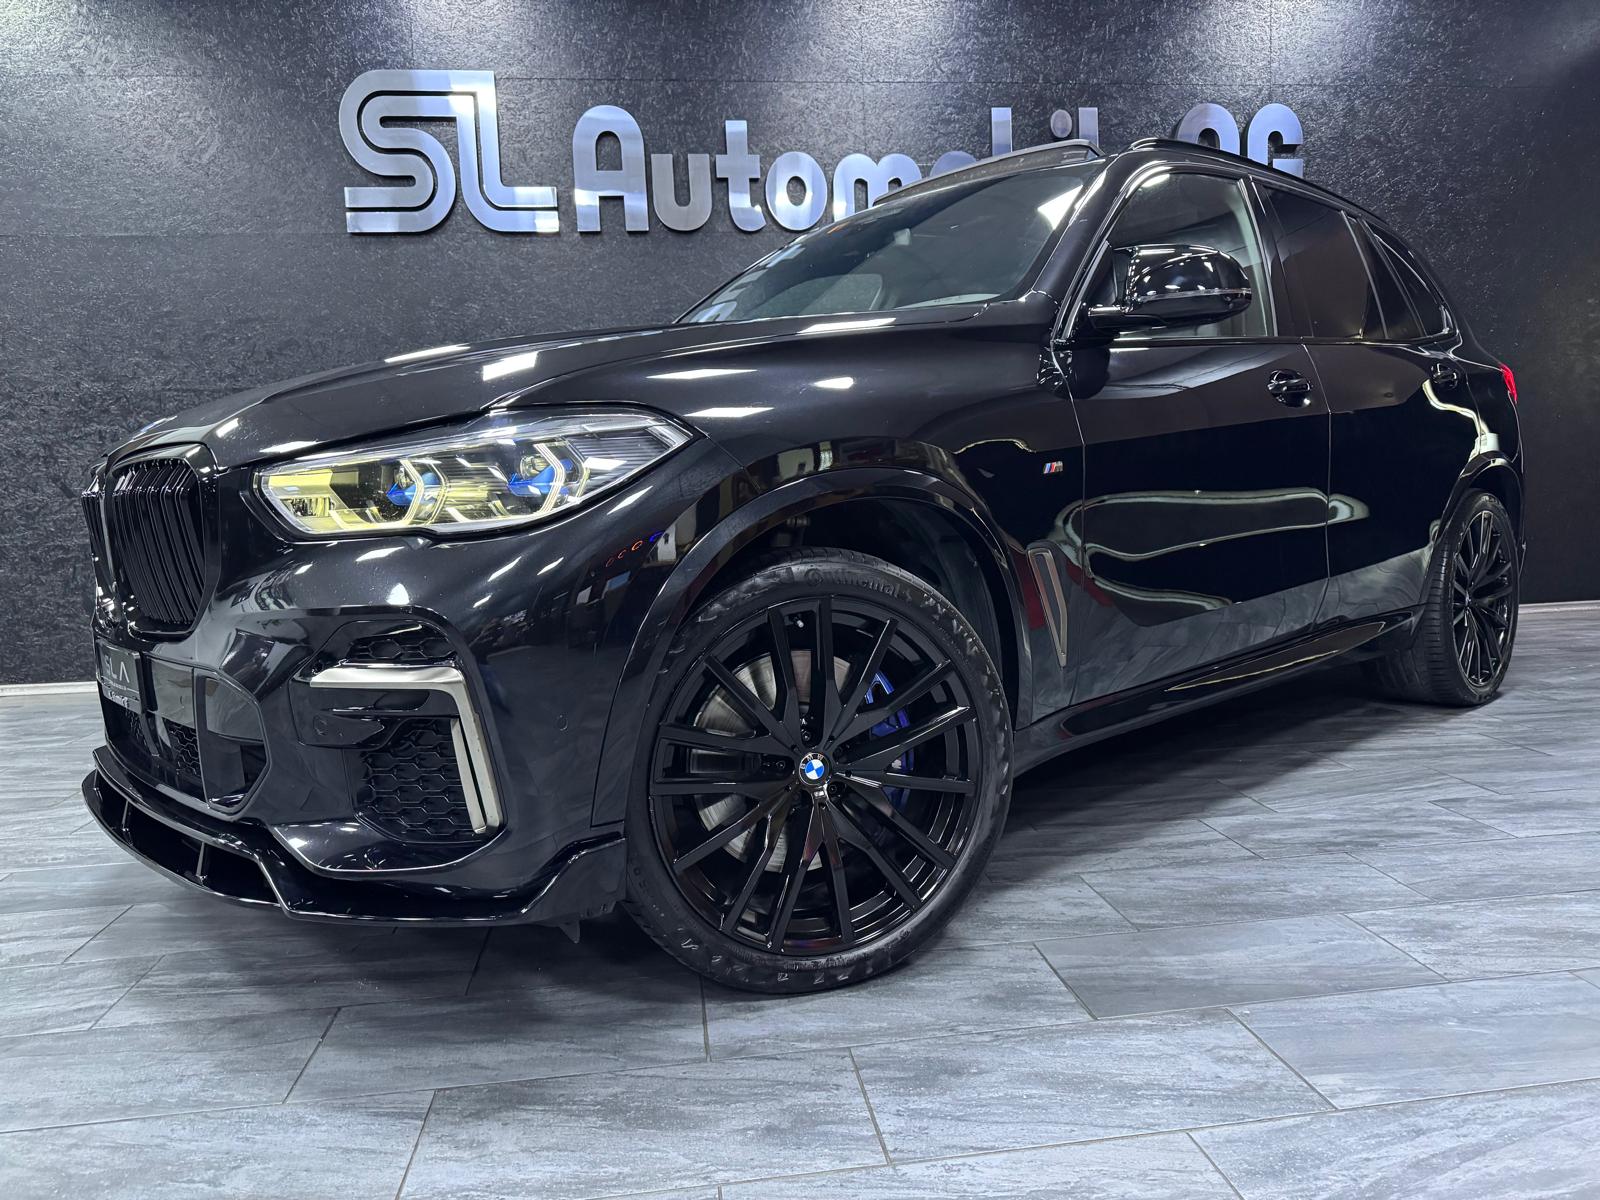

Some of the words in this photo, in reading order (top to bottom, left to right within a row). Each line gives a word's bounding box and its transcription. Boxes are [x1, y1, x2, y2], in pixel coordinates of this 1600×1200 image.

[339, 69, 559, 233] SL
[572, 105, 1099, 232] Autom
[800, 753, 825, 769] BMW
